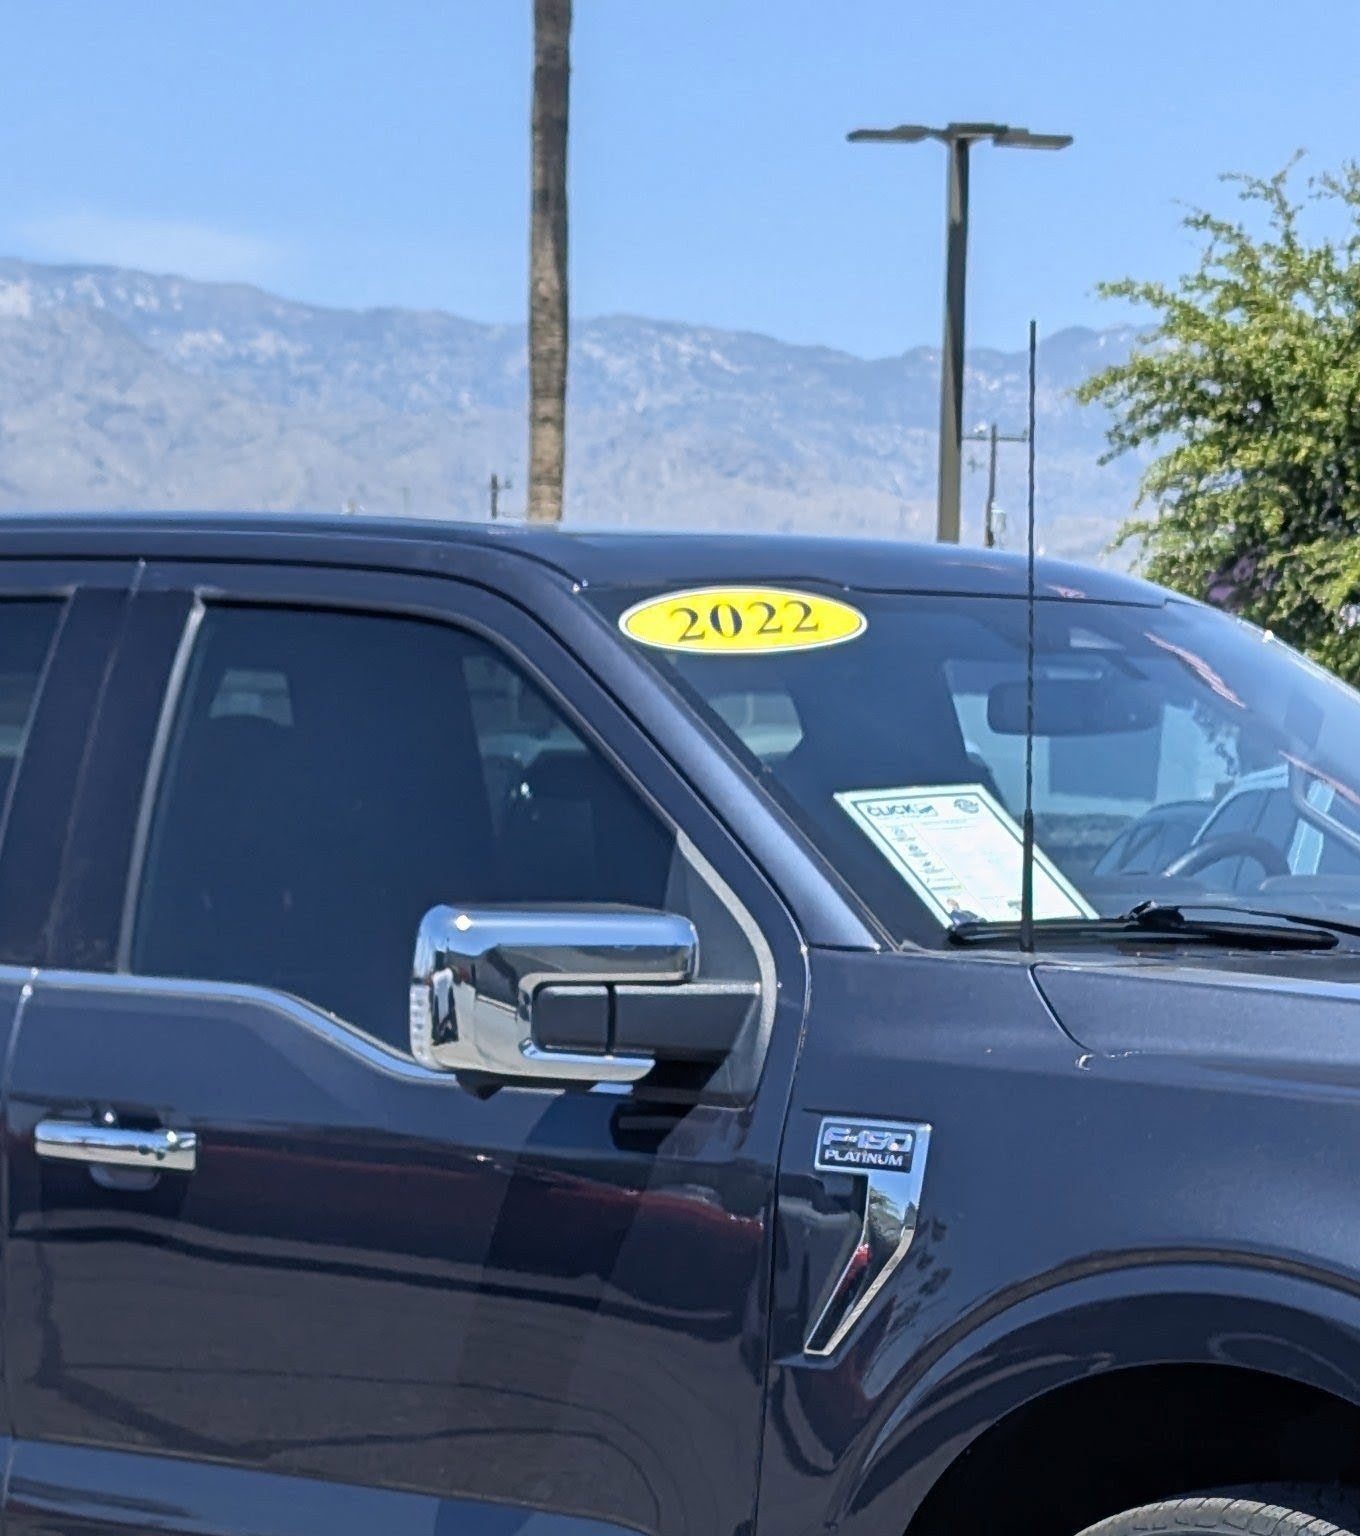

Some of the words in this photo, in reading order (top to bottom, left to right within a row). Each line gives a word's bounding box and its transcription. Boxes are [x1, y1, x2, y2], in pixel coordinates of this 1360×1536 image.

[671, 600, 820, 642] 2022
[823, 1126, 913, 1153] F-150
[824, 1149, 903, 1167] PLATINUM
